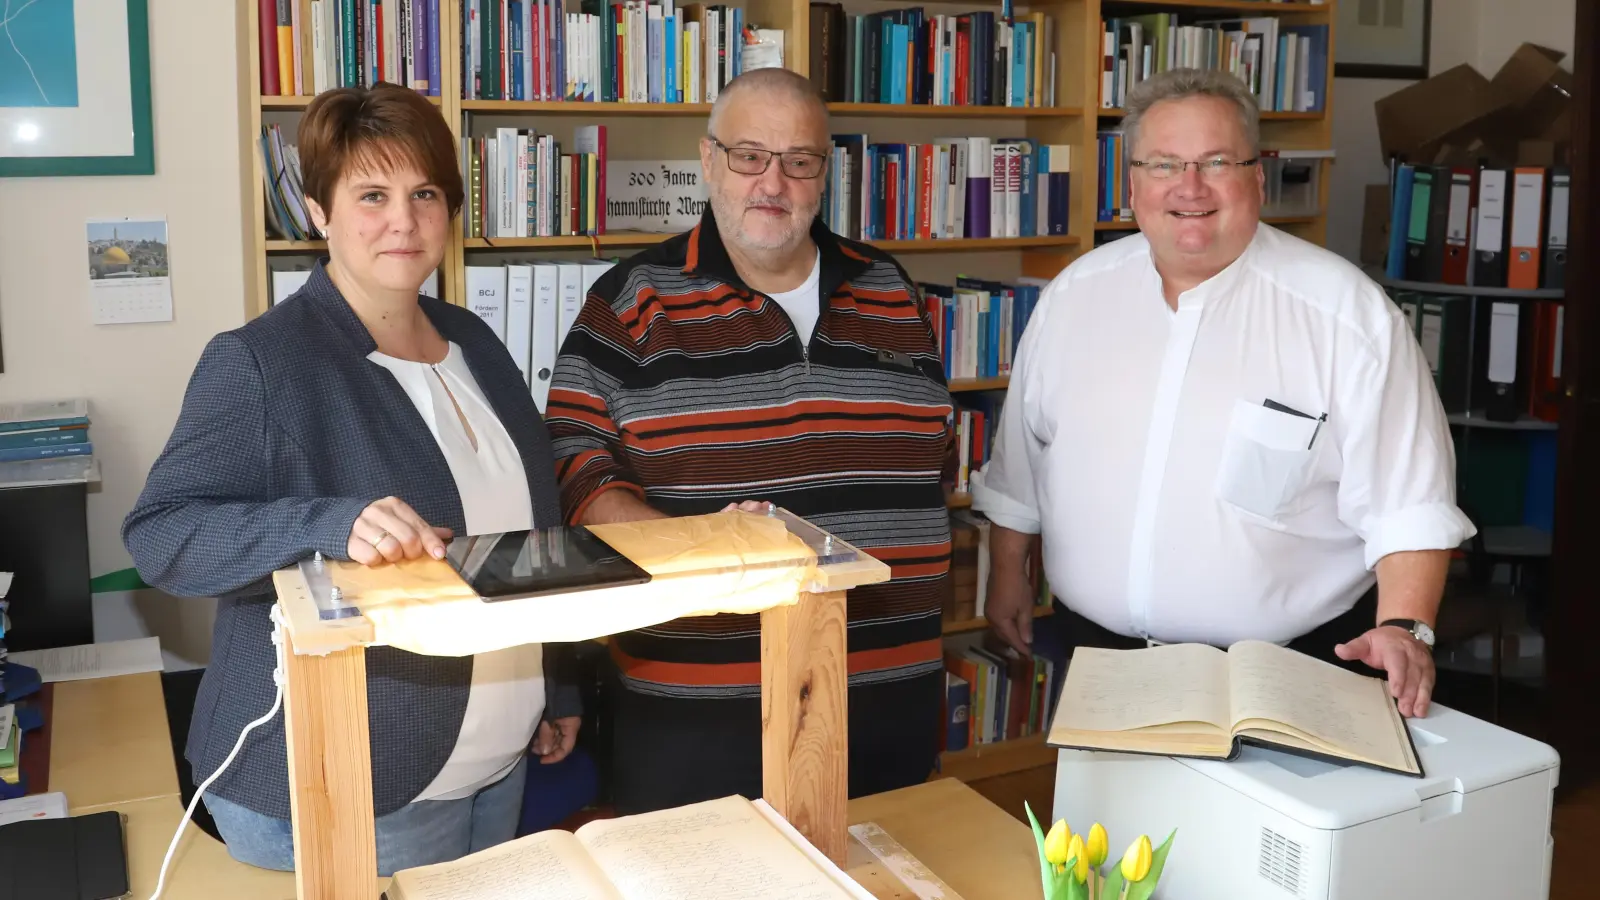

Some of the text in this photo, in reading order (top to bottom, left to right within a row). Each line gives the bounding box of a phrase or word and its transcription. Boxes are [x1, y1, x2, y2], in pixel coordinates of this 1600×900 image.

[629, 169, 697, 188] 300 Jahre
[478, 289, 495, 297] BCJ
